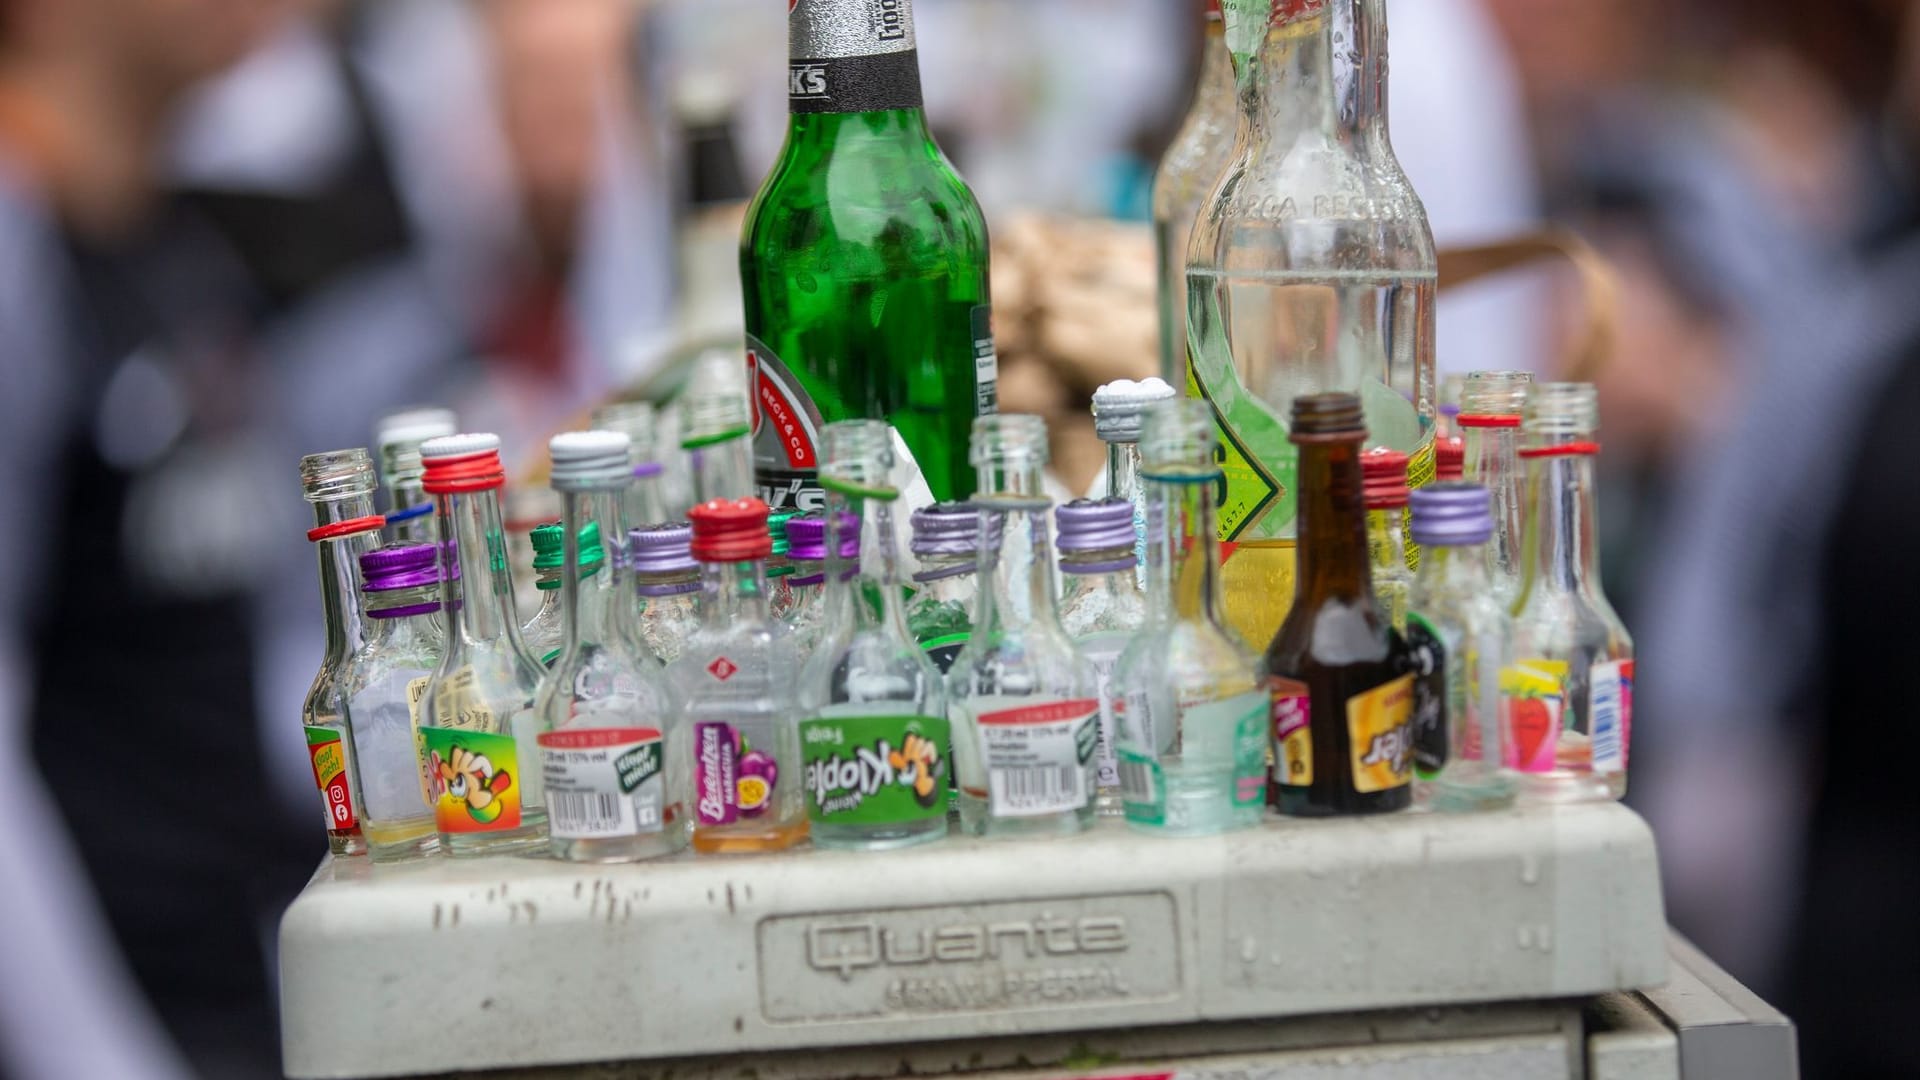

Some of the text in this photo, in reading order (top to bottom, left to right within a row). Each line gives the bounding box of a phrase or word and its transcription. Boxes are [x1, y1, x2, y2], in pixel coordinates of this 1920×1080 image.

[762, 387, 805, 460] BECK & CO
[617, 745, 651, 774] Klopf
[805, 911, 1129, 983] Quante
